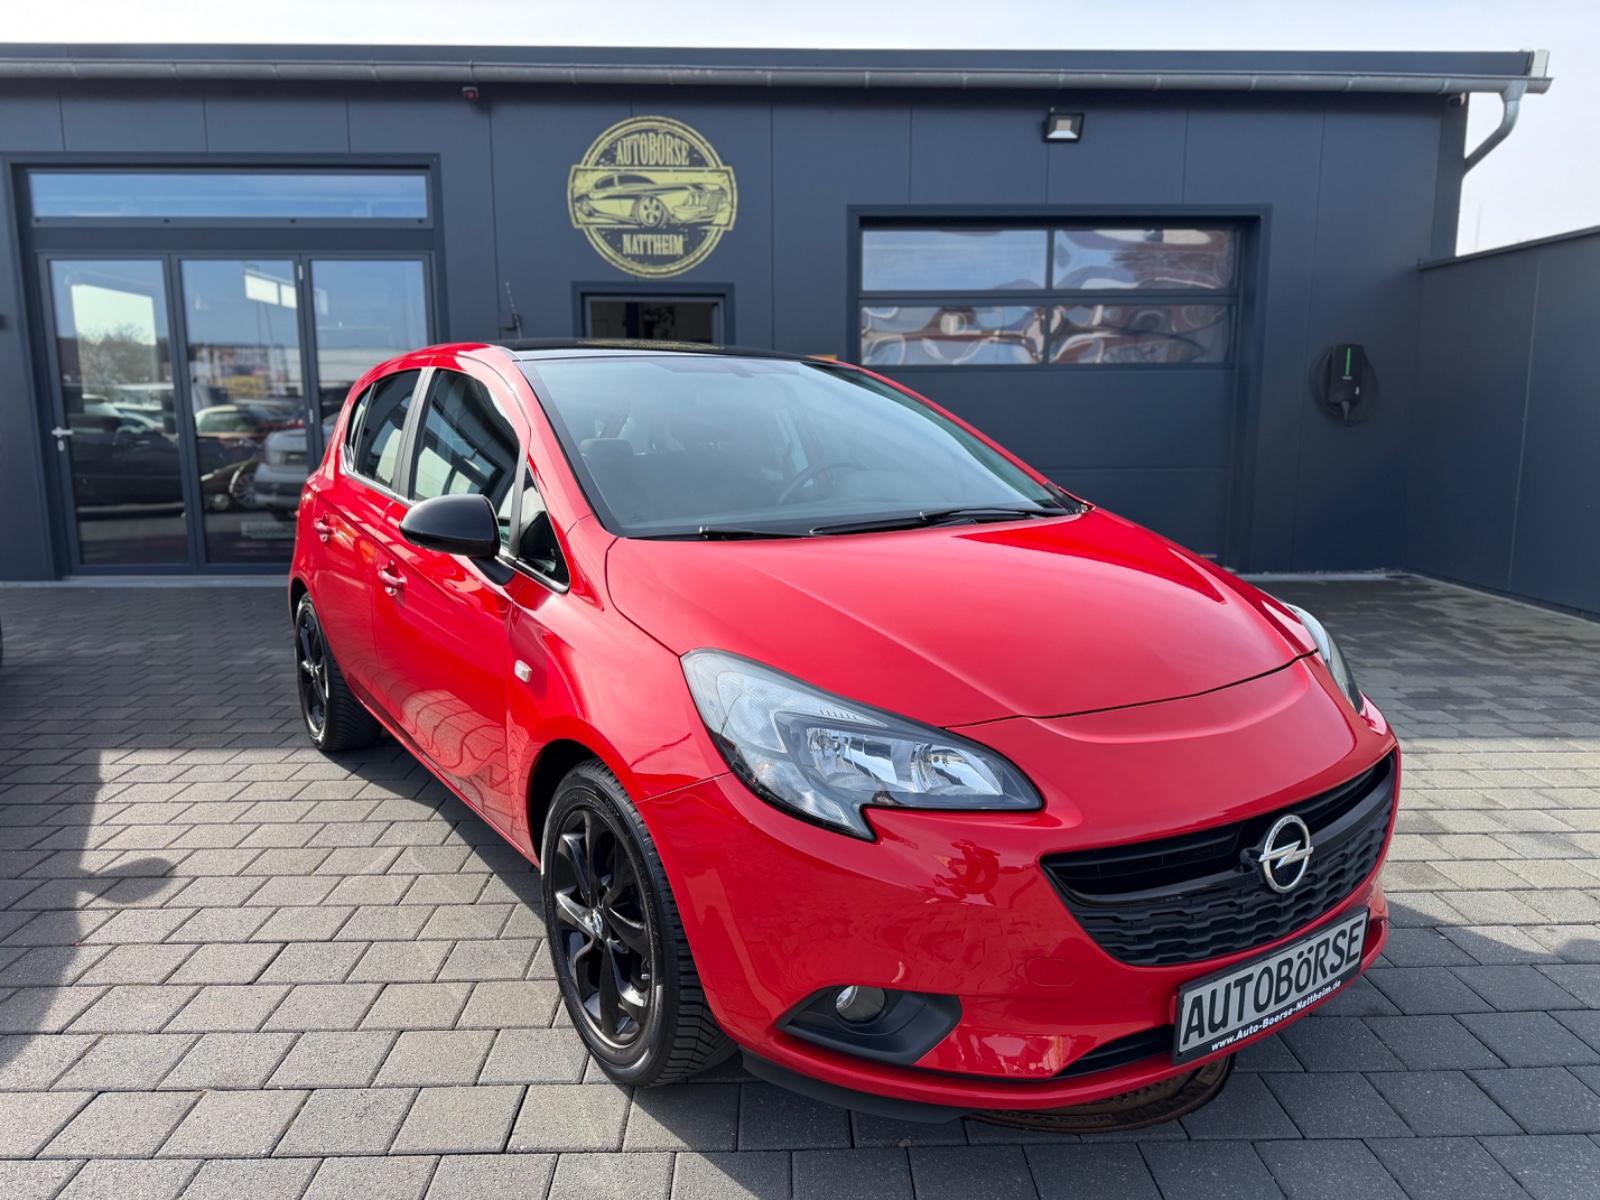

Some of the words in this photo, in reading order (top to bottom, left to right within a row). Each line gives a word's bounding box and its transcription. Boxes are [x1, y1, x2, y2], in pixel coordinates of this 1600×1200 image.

[622, 234, 683, 255] NATTHEIM
[1182, 919, 1363, 1046] AUTOBÖRSE
[1211, 980, 1341, 1052] www.Auto-Boerse-Nattheim.de
